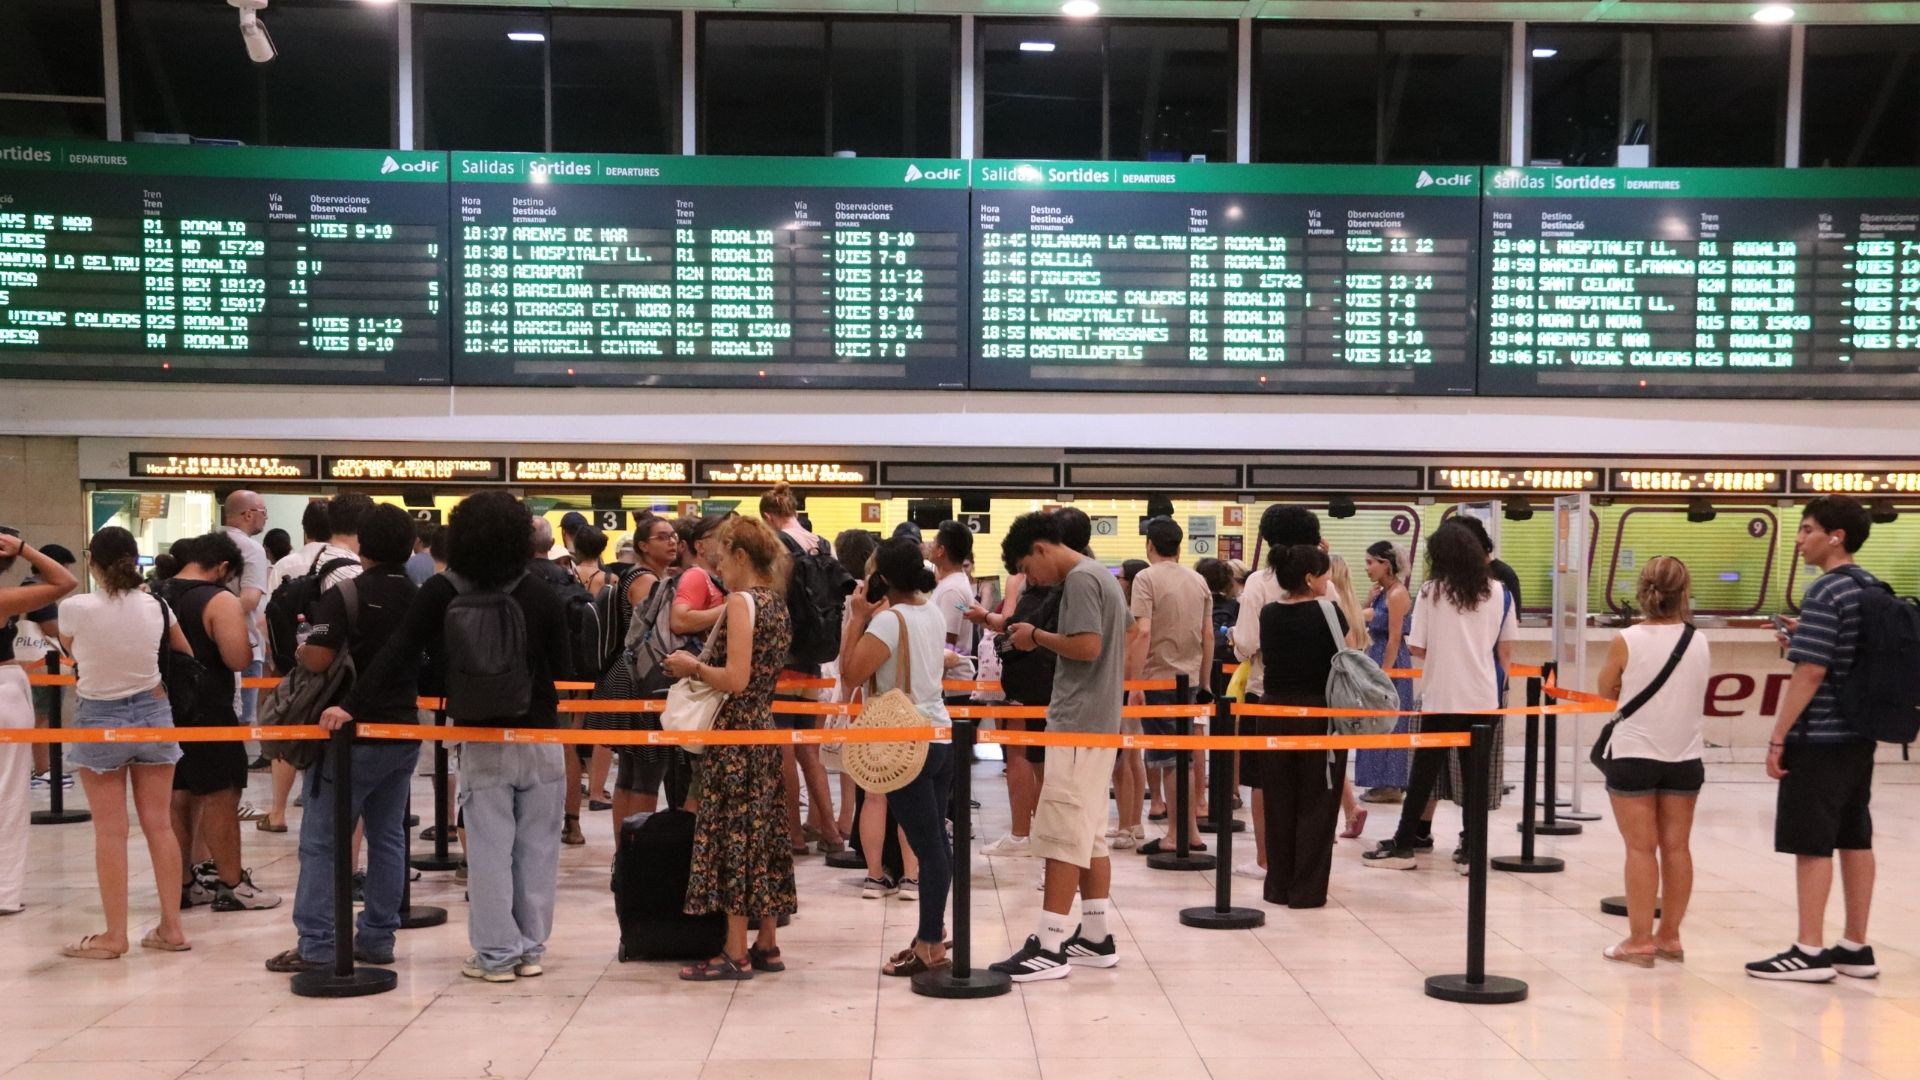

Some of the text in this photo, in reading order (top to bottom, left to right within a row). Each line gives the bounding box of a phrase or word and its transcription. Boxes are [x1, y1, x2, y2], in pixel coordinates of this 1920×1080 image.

[0, 147, 51, 162] rtides
[69, 154, 128, 166] DEPARTURES
[401, 160, 440, 173] adif
[462, 160, 515, 174] Salidas
[529, 160, 592, 176] Sortides
[606, 167, 661, 177] DEPARTURES
[924, 168, 962, 180] adif
[1048, 168, 1110, 183] Sortides
[1122, 174, 1176, 184] DEPARTURES
[1435, 174, 1473, 186] adif
[1494, 175, 1545, 189] Salidas
[1555, 175, 1616, 190] Sortides
[1627, 180, 1681, 190] DEPARTURES
[143, 190, 162, 199] Tren
[310, 195, 370, 204] Observaciones
[143, 200, 163, 208] Tren
[461, 197, 481, 205] Hora
[512, 197, 544, 206] Destino
[676, 200, 694, 208] Tren
[835, 202, 893, 211] Observaciones
[269, 203, 283, 212] Via
[310, 205, 367, 213] Observacions
[461, 206, 482, 215] Hora
[512, 206, 557, 216] Destinació
[676, 209, 695, 217] Tren
[981, 205, 1000, 213] Hora
[1030, 206, 1062, 214] Destino
[1190, 208, 1207, 216] Tren
[795, 210, 808, 219] Via
[835, 211, 890, 220] Observacions
[981, 214, 1000, 222] Hora
[1030, 214, 1074, 224] Destinació
[1348, 210, 1405, 219] Observaciones
[1493, 212, 1512, 220] Hora
[1541, 212, 1573, 220] Destino
[1701, 213, 1719, 221] Tren
[1190, 217, 1208, 226] Tren
[1308, 219, 1321, 227] Via
[1348, 219, 1401, 228] Observacions
[1493, 221, 1512, 229] Hora
[1541, 220, 1585, 230] Destinació
[1701, 222, 1719, 231] Tren
[513, 227, 628, 244] ARENYS DE MAR
[677, 229, 914, 246] R1 RODALIA VIES 9-10
[1108, 235, 1127, 249] LA
[530, 243, 619, 261] HOSPITALET
[627, 247, 652, 261] LL.
[677, 248, 906, 265] R1 RODALIA VIES 7-8
[513, 264, 584, 279] AEROPORT
[677, 266, 923, 283] R2N RODALIA VIES 11-12
[513, 283, 593, 298] BARCELONA
[712, 285, 923, 302] RODALIA VIES 13-14
[1031, 289, 1056, 303] ST.
[1065, 289, 1118, 304] VICENC
[1124, 290, 1186, 307] CALDERS
[1190, 291, 1208, 305] R4
[1224, 292, 1285, 306] RODALIA
[1346, 293, 1382, 307] VIES
[515, 302, 584, 316] TERRASSA
[592, 303, 625, 317] EST.
[636, 303, 671, 317] NORD
[677, 304, 914, 320] R4 RODALIA VIES 9-10
[983, 306, 1167, 323] 18:53 HOSPITALET LL.
[1190, 310, 1415, 326] R1 RODALIA VIES 7-8
[983, 325, 1025, 340] 18:55
[1190, 328, 1423, 344] R1 RODALIA VIES 9-10
[712, 341, 773, 355] RODALIA
[982, 344, 1143, 360] 18:55 CASTELLDEFELS
[1190, 347, 1431, 363] R2 RODALIA VIES 11-12
[603, 511, 617, 530] 3
[968, 514, 981, 533] 5
[1397, 519, 1405, 531] 7
[1753, 521, 1763, 534] 9
